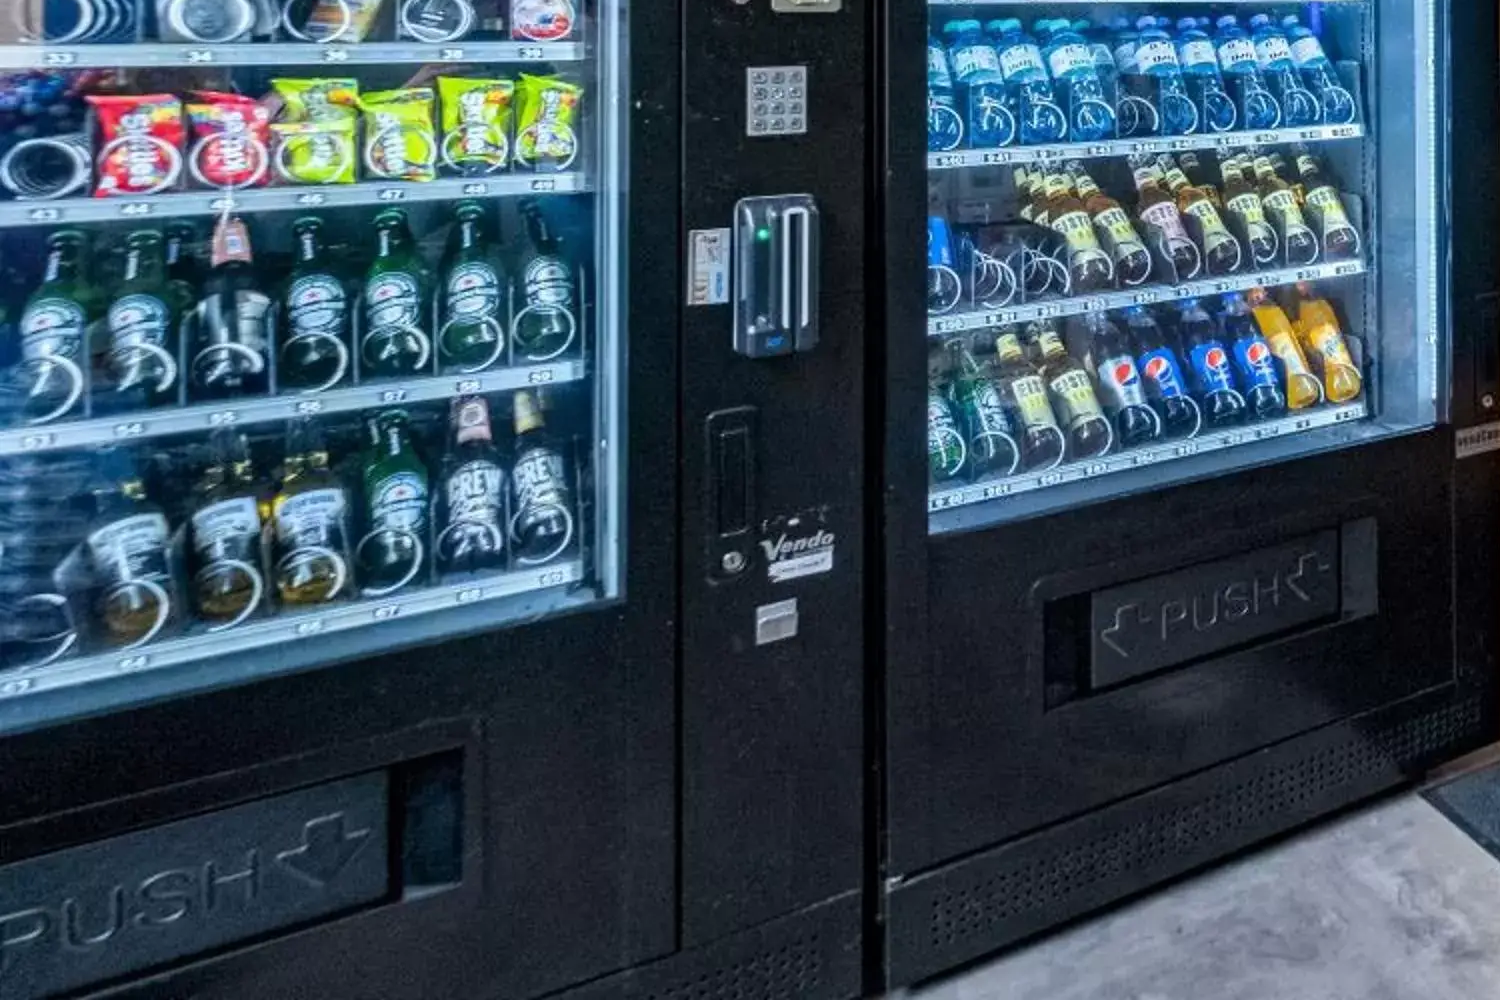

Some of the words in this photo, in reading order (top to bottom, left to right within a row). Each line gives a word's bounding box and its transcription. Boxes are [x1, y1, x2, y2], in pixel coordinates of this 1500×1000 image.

[448, 468, 503, 507] CREW
[513, 454, 564, 497] CREW
[760, 528, 835, 561] Vendo
[1161, 567, 1279, 642] PUSH
[0, 848, 259, 972] PUSH
